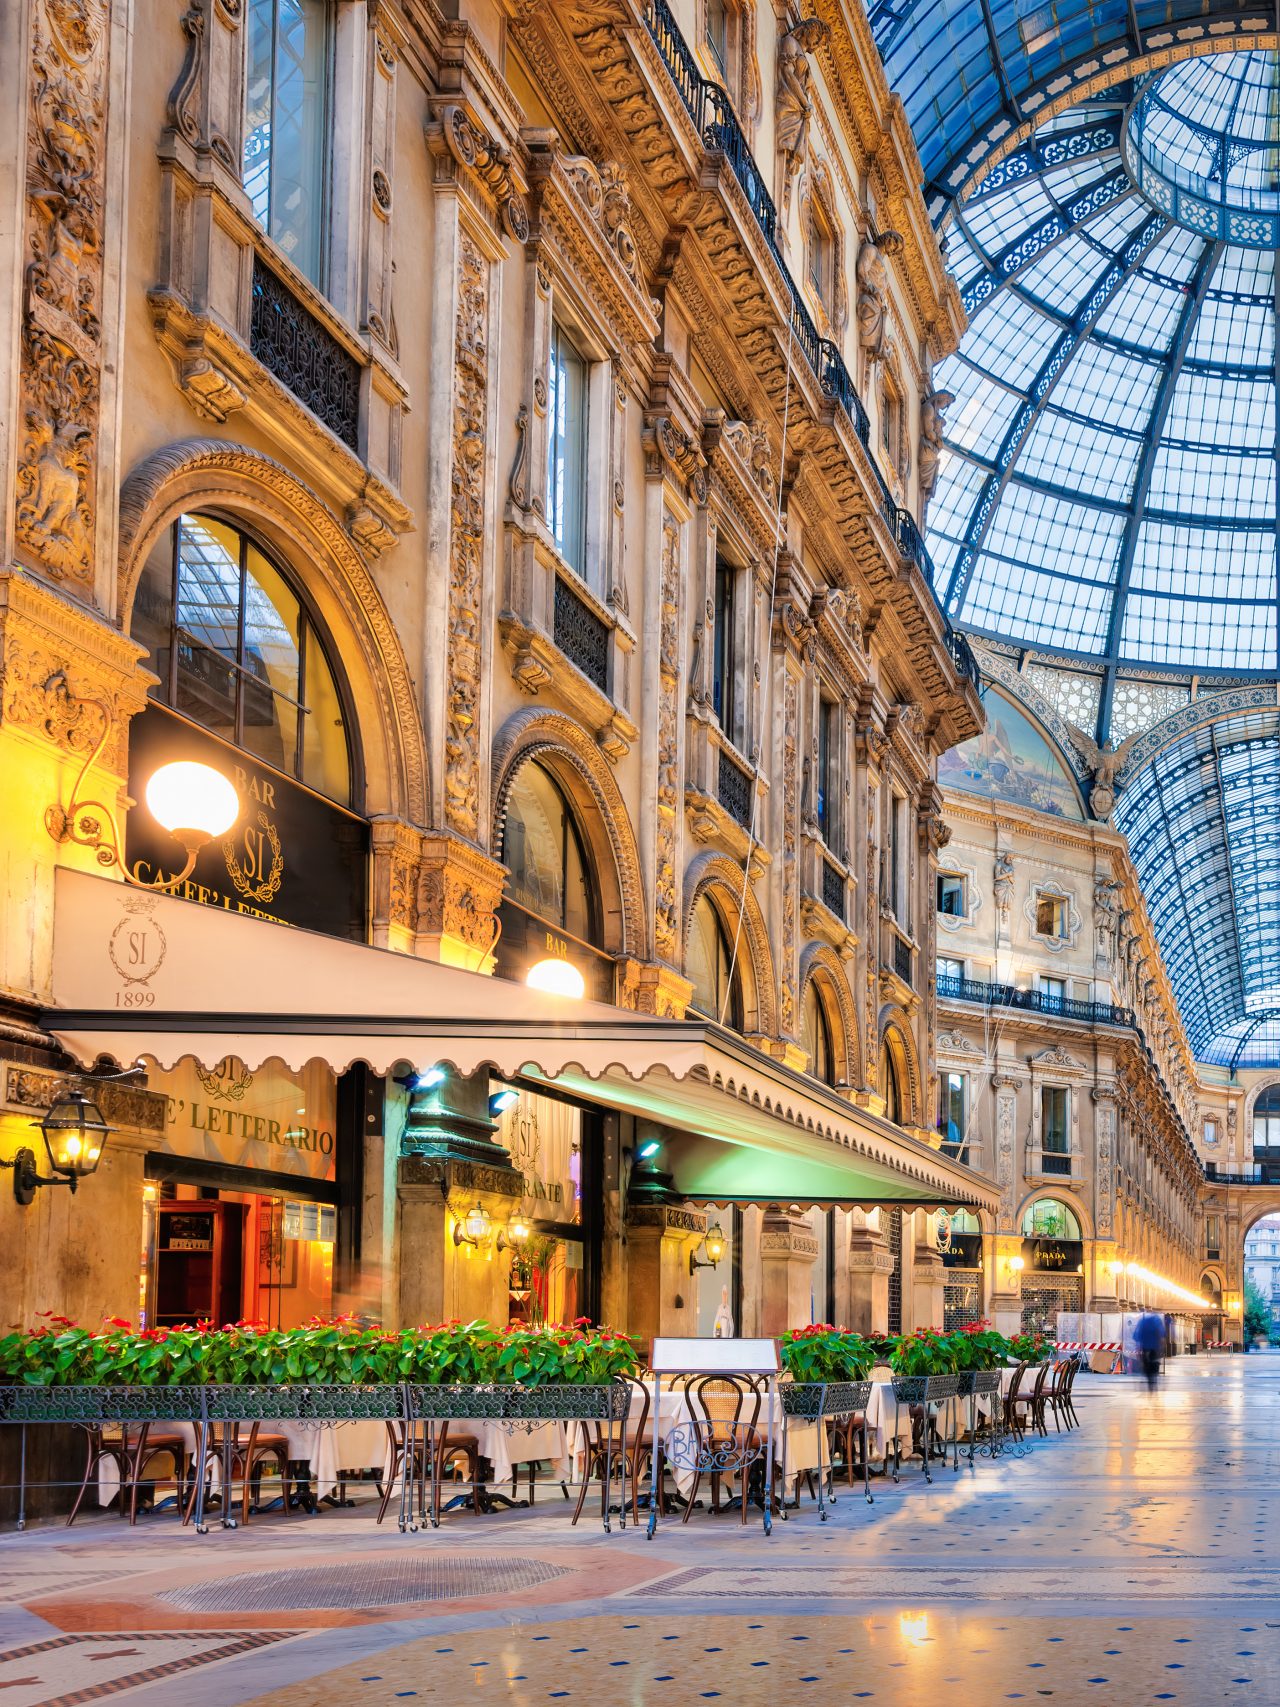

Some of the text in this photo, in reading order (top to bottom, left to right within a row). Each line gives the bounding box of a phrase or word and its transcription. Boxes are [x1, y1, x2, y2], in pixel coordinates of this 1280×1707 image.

[232, 764, 277, 810] BAR
[244, 826, 265, 883] SI
[128, 931, 148, 965] SI
[546, 932, 567, 960] BAR
[114, 992, 156, 1007] 1899
[191, 1102, 334, 1155] LETTERARIO
[520, 1120, 532, 1157] SI
[1036, 1251, 1066, 1260] PRADA
